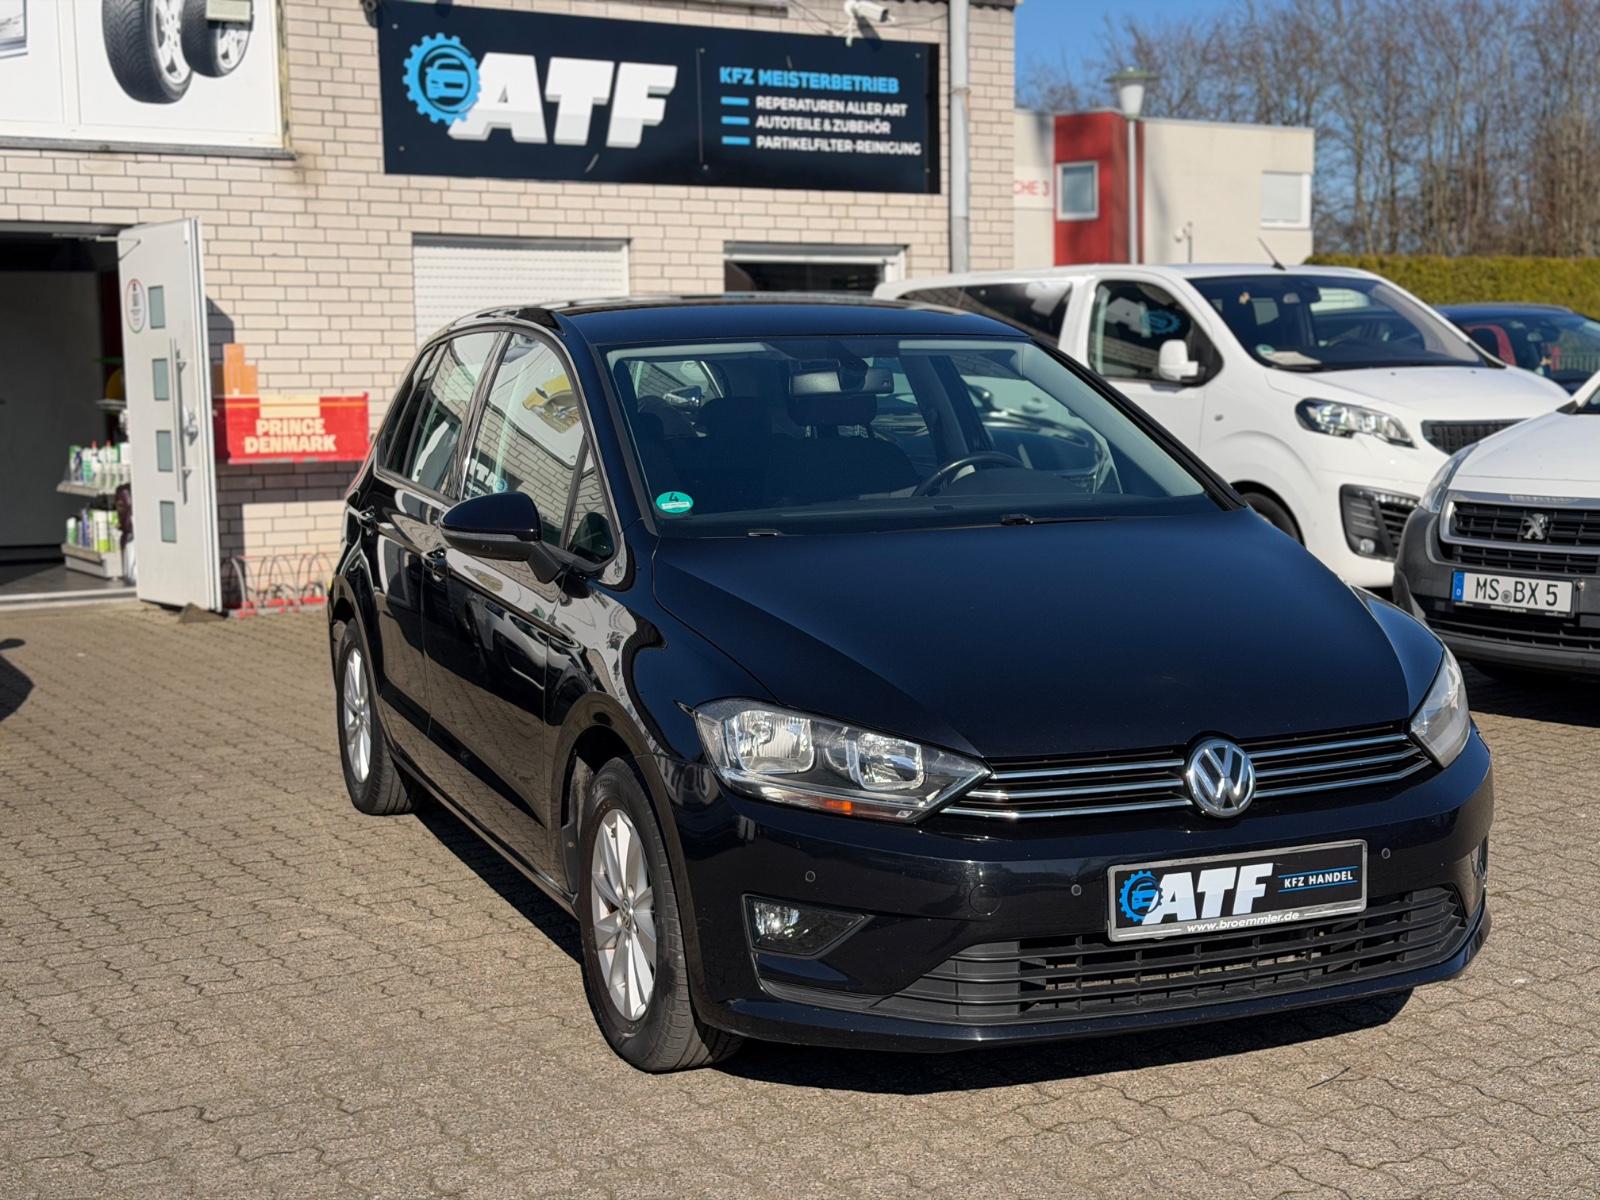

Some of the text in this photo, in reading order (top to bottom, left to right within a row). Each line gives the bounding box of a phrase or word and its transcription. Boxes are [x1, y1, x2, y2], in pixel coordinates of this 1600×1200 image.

[719, 66, 899, 94] KFZ MEISTERBETRIEB
[448, 52, 678, 148] ATF
[755, 95, 908, 117] REPERATUREN ALLER ART
[755, 115, 891, 135] AUTOTEILE & ZUBEHÖR
[755, 135, 922, 156] PARTIKELFILTER-REINIGUNG
[255, 418, 326, 436] PRINCE
[244, 434, 337, 454] DENMARK
[1474, 577, 1559, 607] MS BX 5
[1284, 870, 1353, 889] KFZ HANDEL
[1141, 862, 1274, 926] ATF
